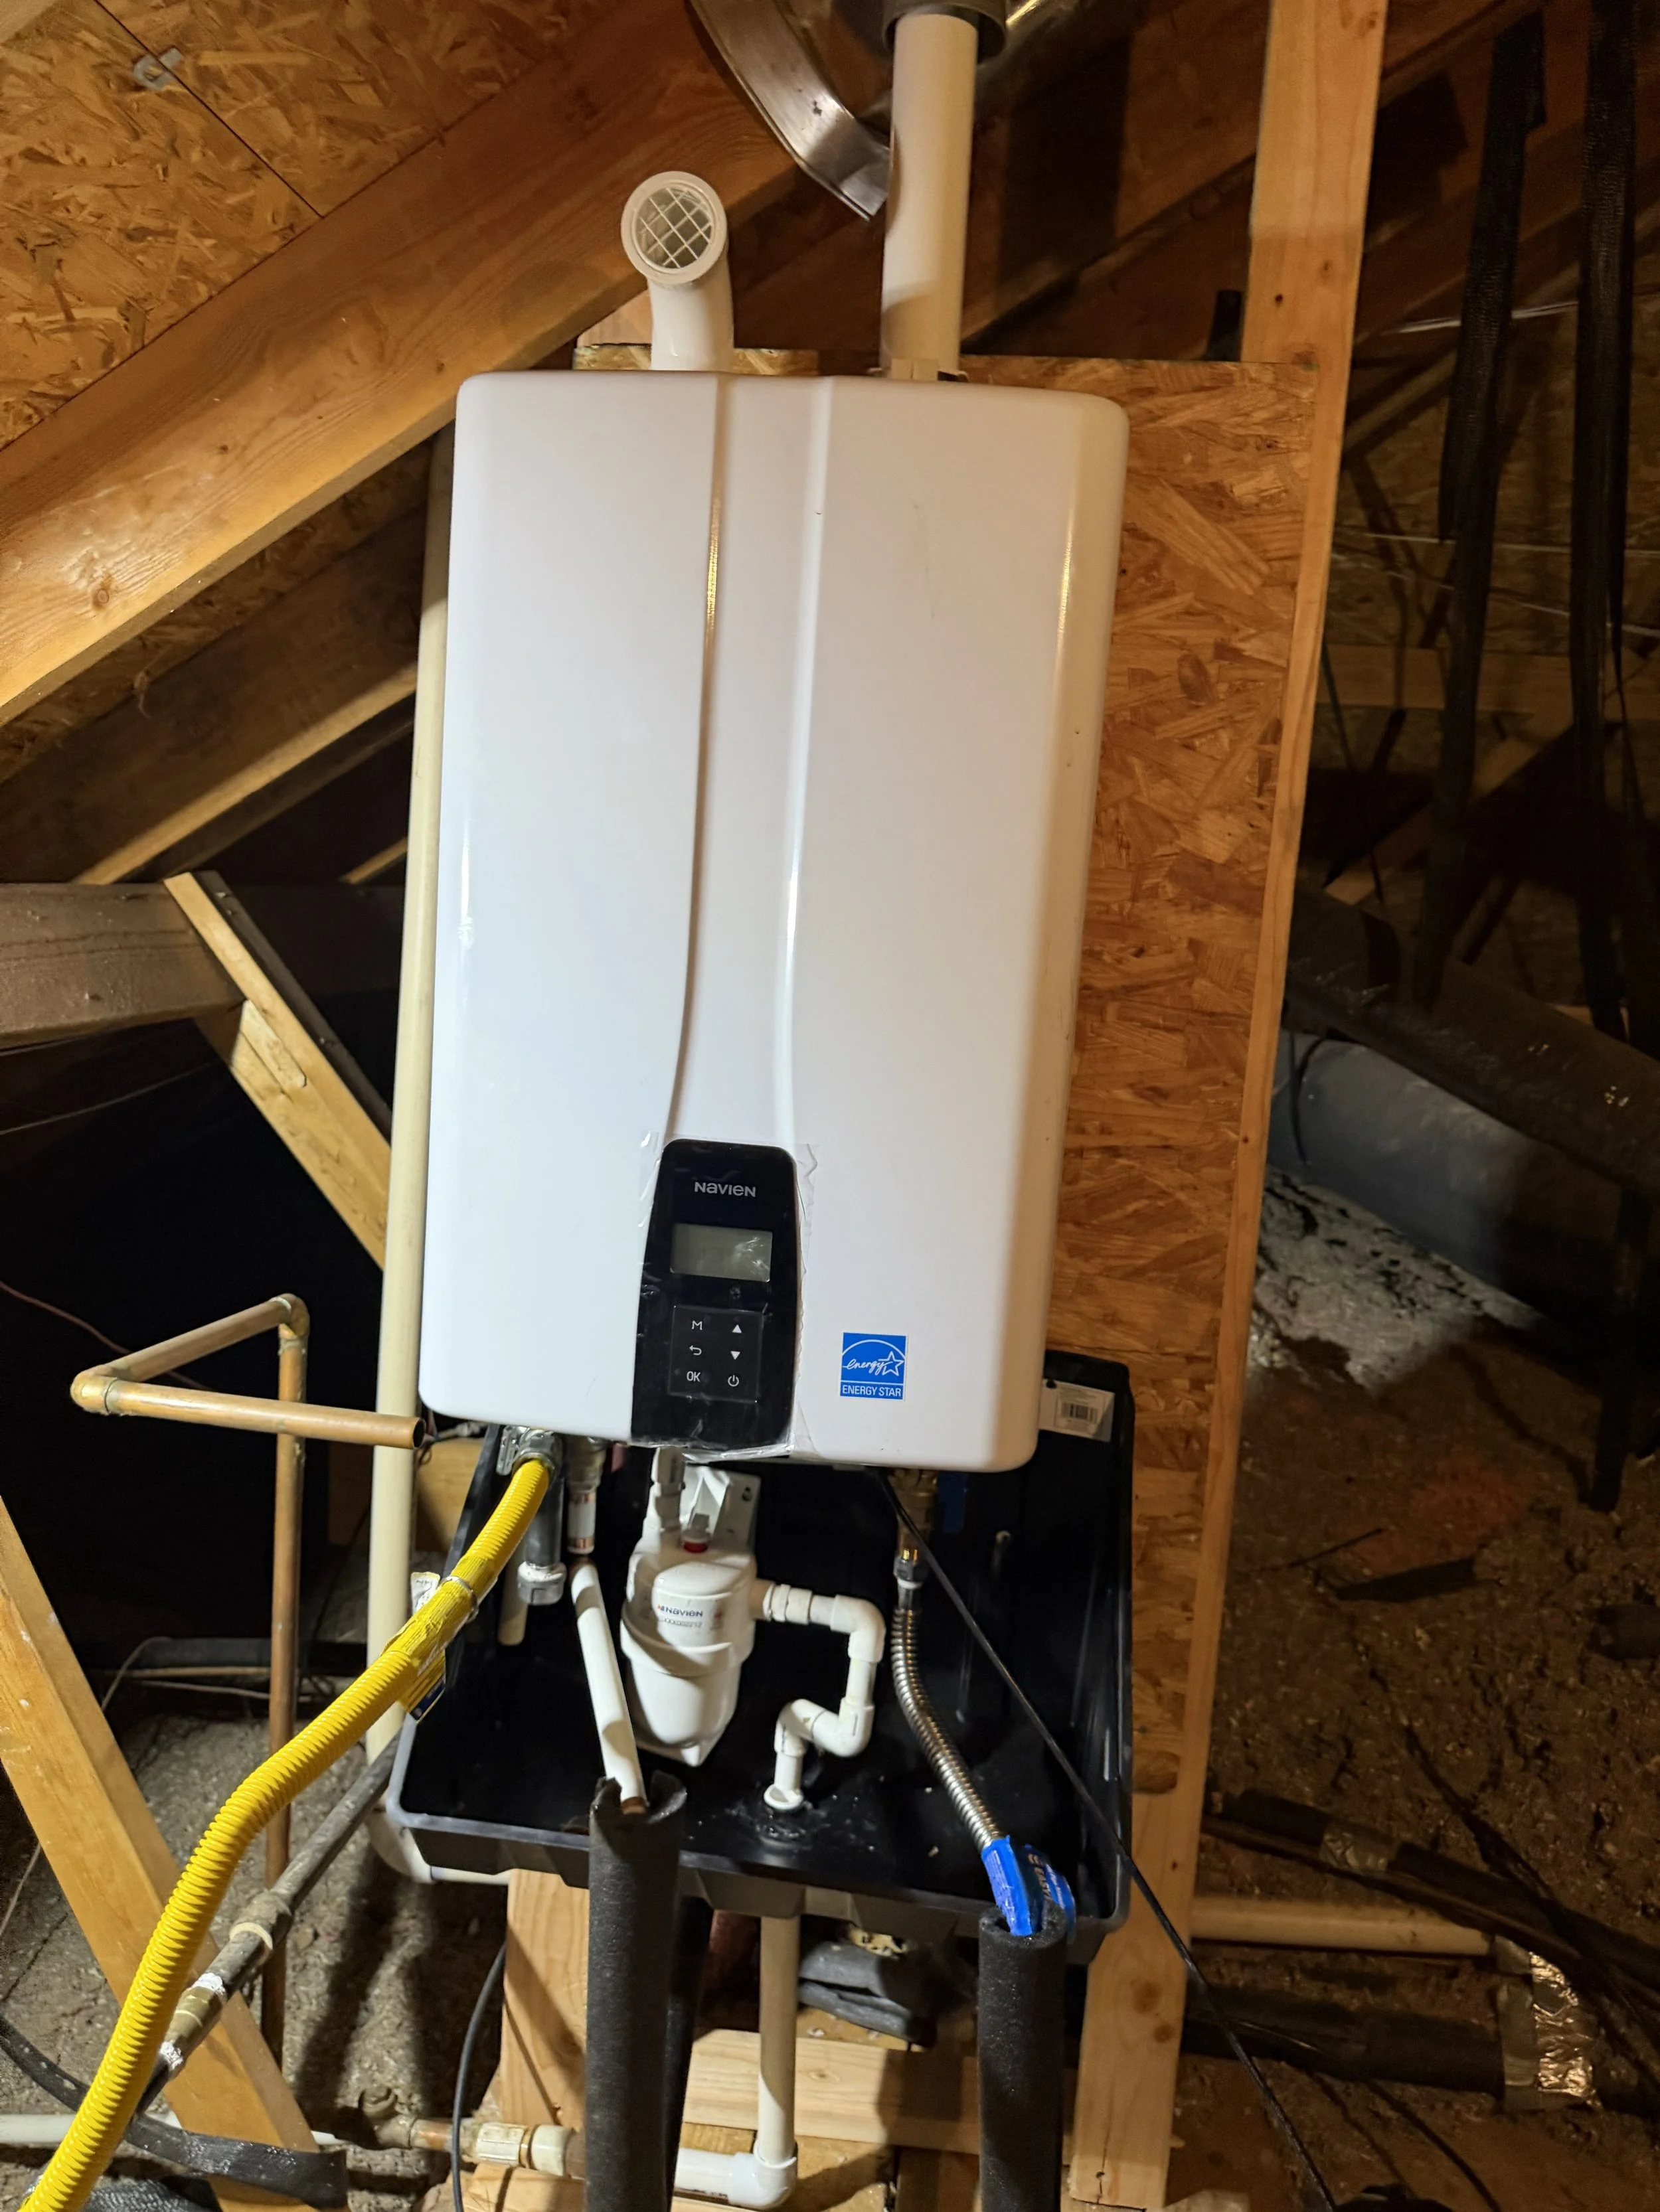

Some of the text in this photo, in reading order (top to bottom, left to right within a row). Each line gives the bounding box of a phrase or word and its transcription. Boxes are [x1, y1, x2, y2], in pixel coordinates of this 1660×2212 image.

[691, 1320, 703, 1330] M
[845, 1358, 888, 1376] energy
[686, 1371, 701, 1382] OK
[842, 1384, 902, 1397] ENERGY STAR
